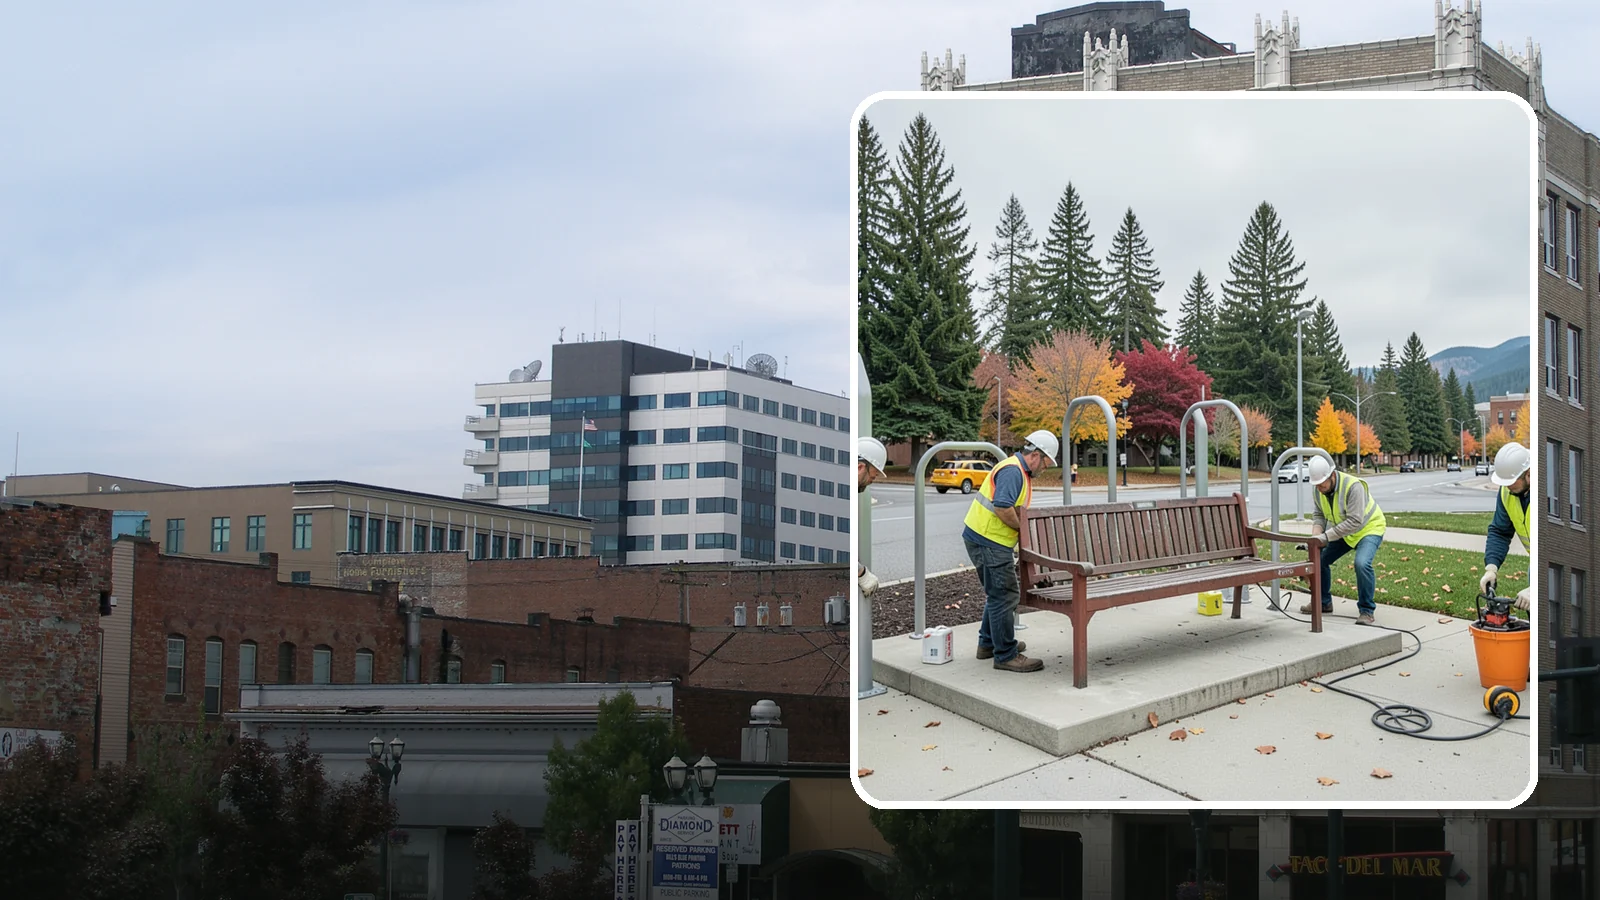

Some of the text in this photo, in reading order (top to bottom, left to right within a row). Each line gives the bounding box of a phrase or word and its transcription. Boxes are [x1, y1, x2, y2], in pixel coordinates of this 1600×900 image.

[370, 566, 428, 577] Furnishers
[660, 818, 713, 833] DIAMOND
[1022, 815, 1070, 828] BUILDING
[655, 845, 716, 854] RESERVED PARKING
[616, 824, 625, 894] PAY HERE
[627, 824, 637, 893] PAY HERE
[671, 862, 701, 870] PATRONS
[1289, 855, 1443, 877] TAC DEL MAR
[660, 888, 710, 898] PUBLIC PARKING
